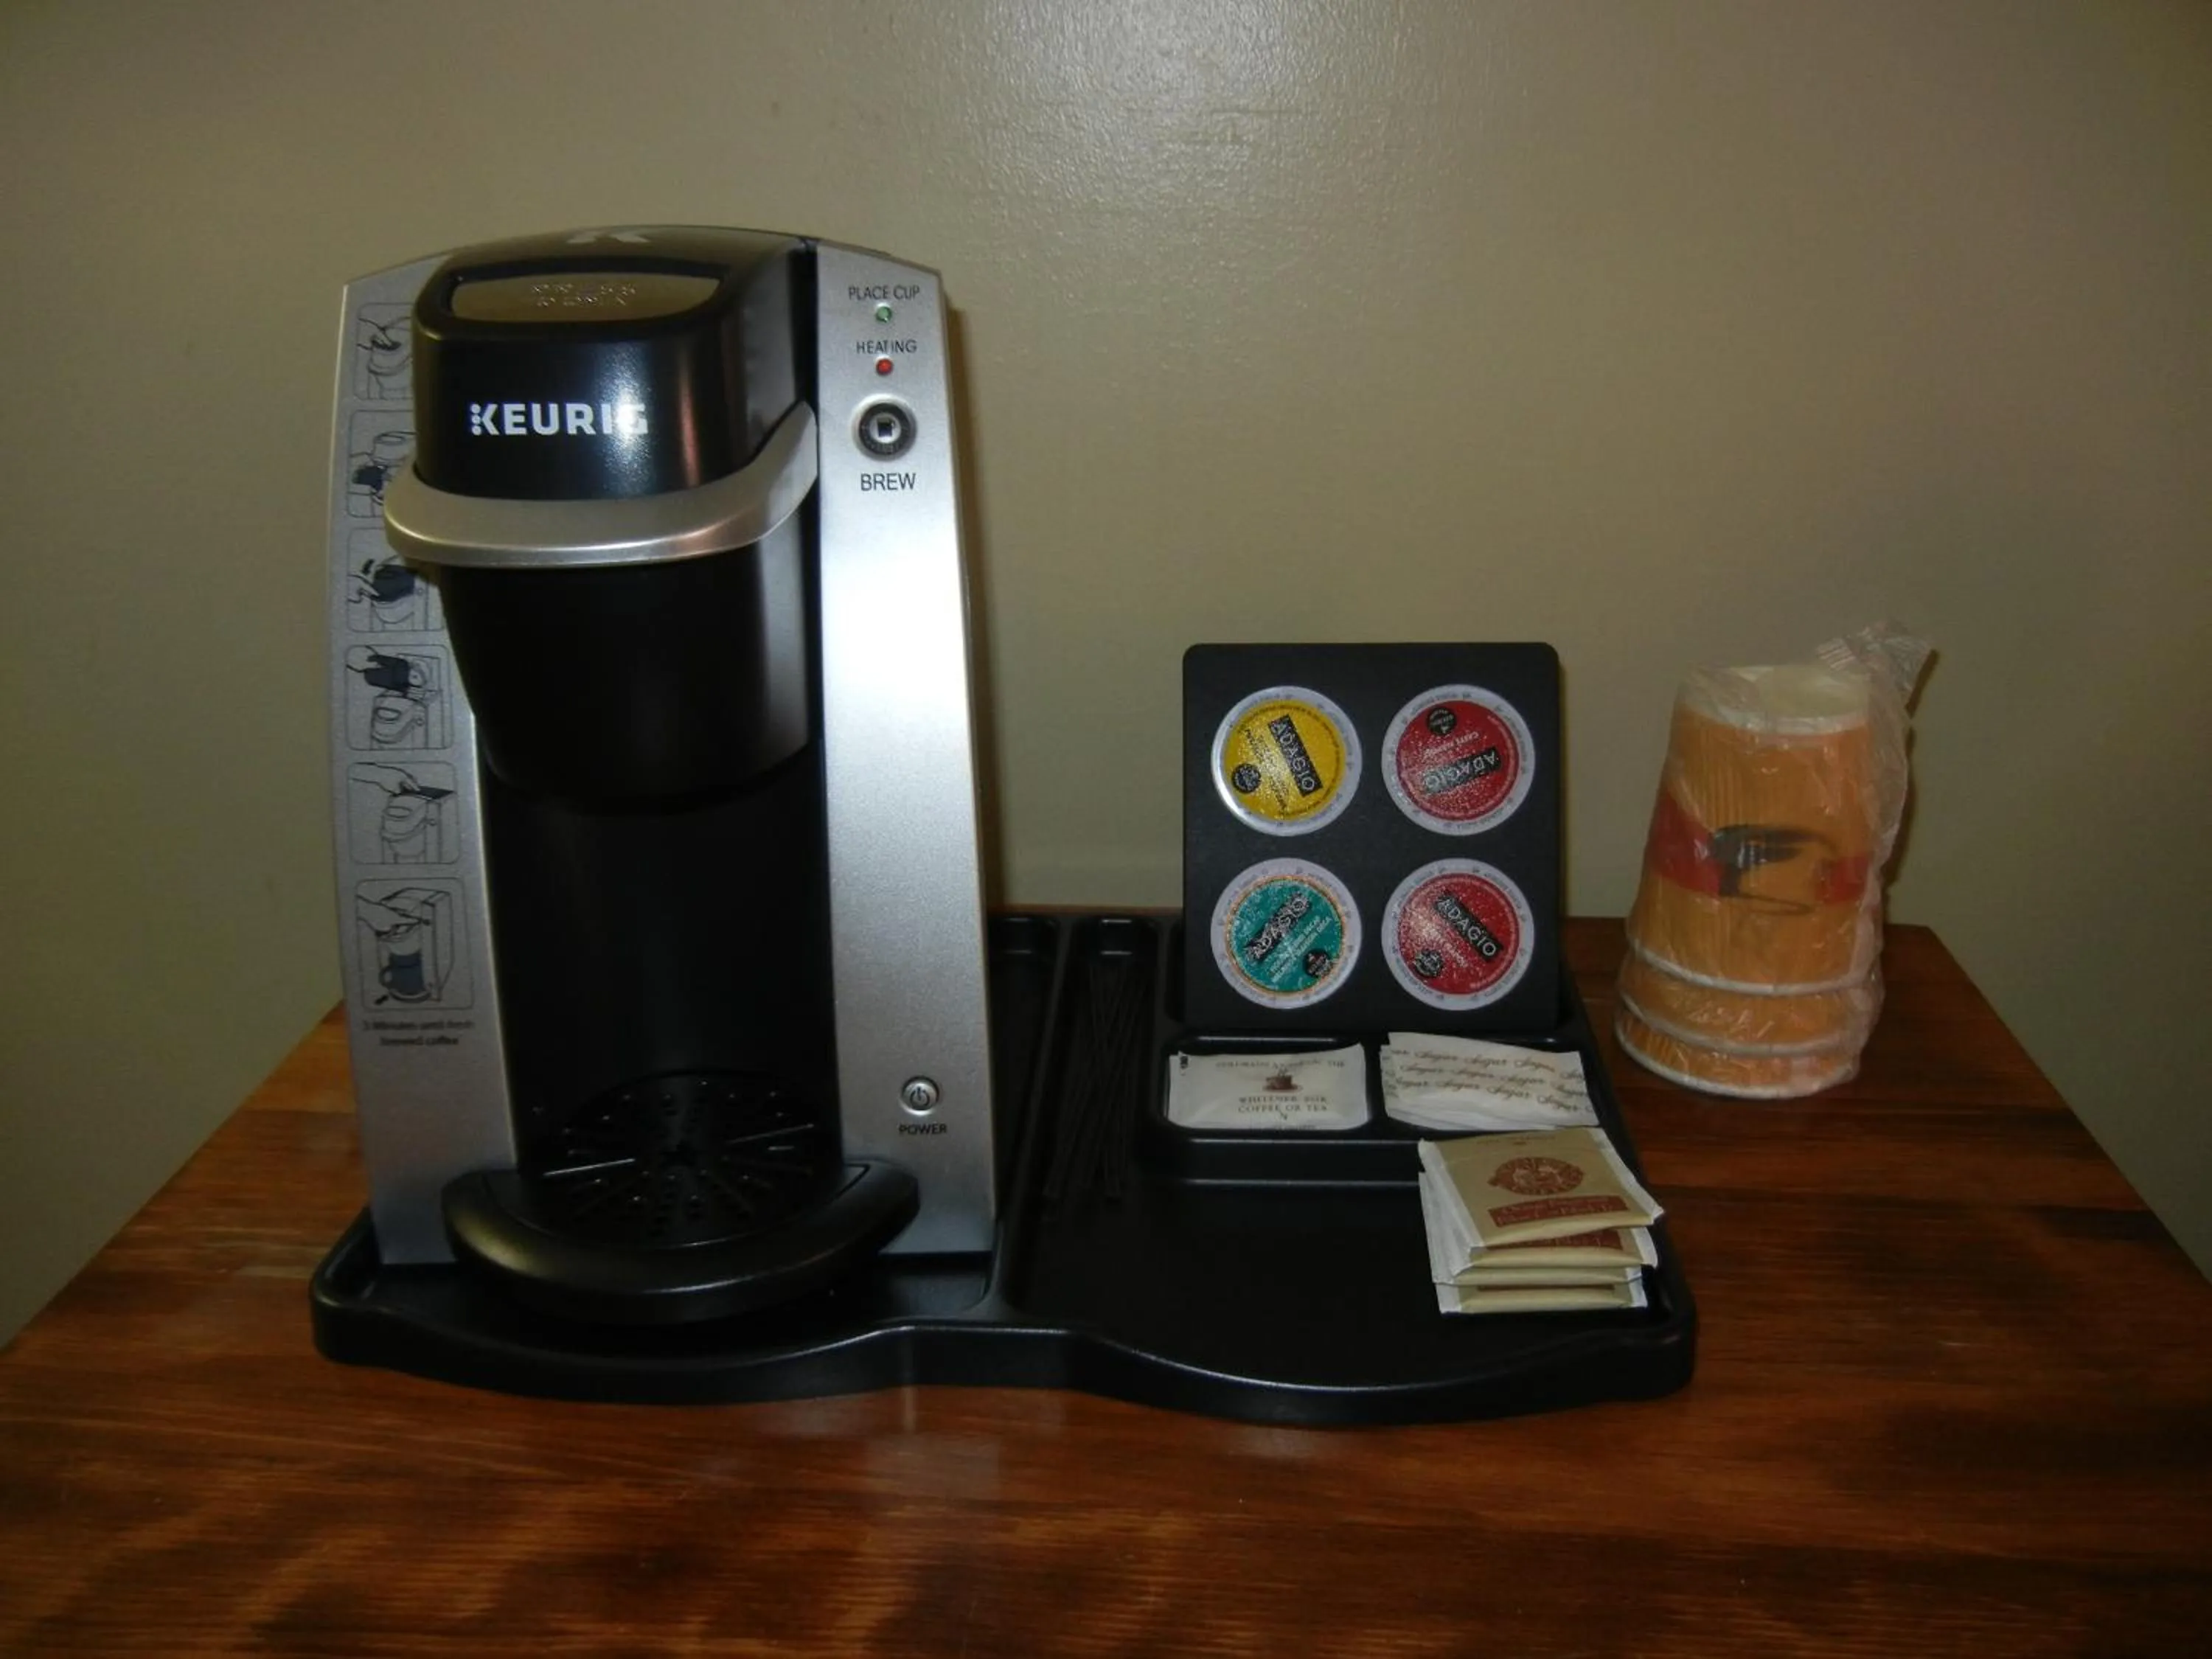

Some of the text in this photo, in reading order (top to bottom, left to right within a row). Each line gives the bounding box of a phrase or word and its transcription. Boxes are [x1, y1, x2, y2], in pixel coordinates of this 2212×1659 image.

[849, 285, 920, 300] PLACE CUP
[856, 340, 918, 354] HEATING
[470, 403, 649, 436] KEURIG
[860, 473, 916, 491] BREW
[1271, 720, 1315, 791] ADAGIO
[1424, 751, 1497, 789] ADAGIO
[1247, 894, 1309, 960] ADAGIO
[1437, 897, 1497, 956] ADAGIO
[1238, 1105, 1281, 1113] COFFEE
[899, 1124, 947, 1135] POWER
